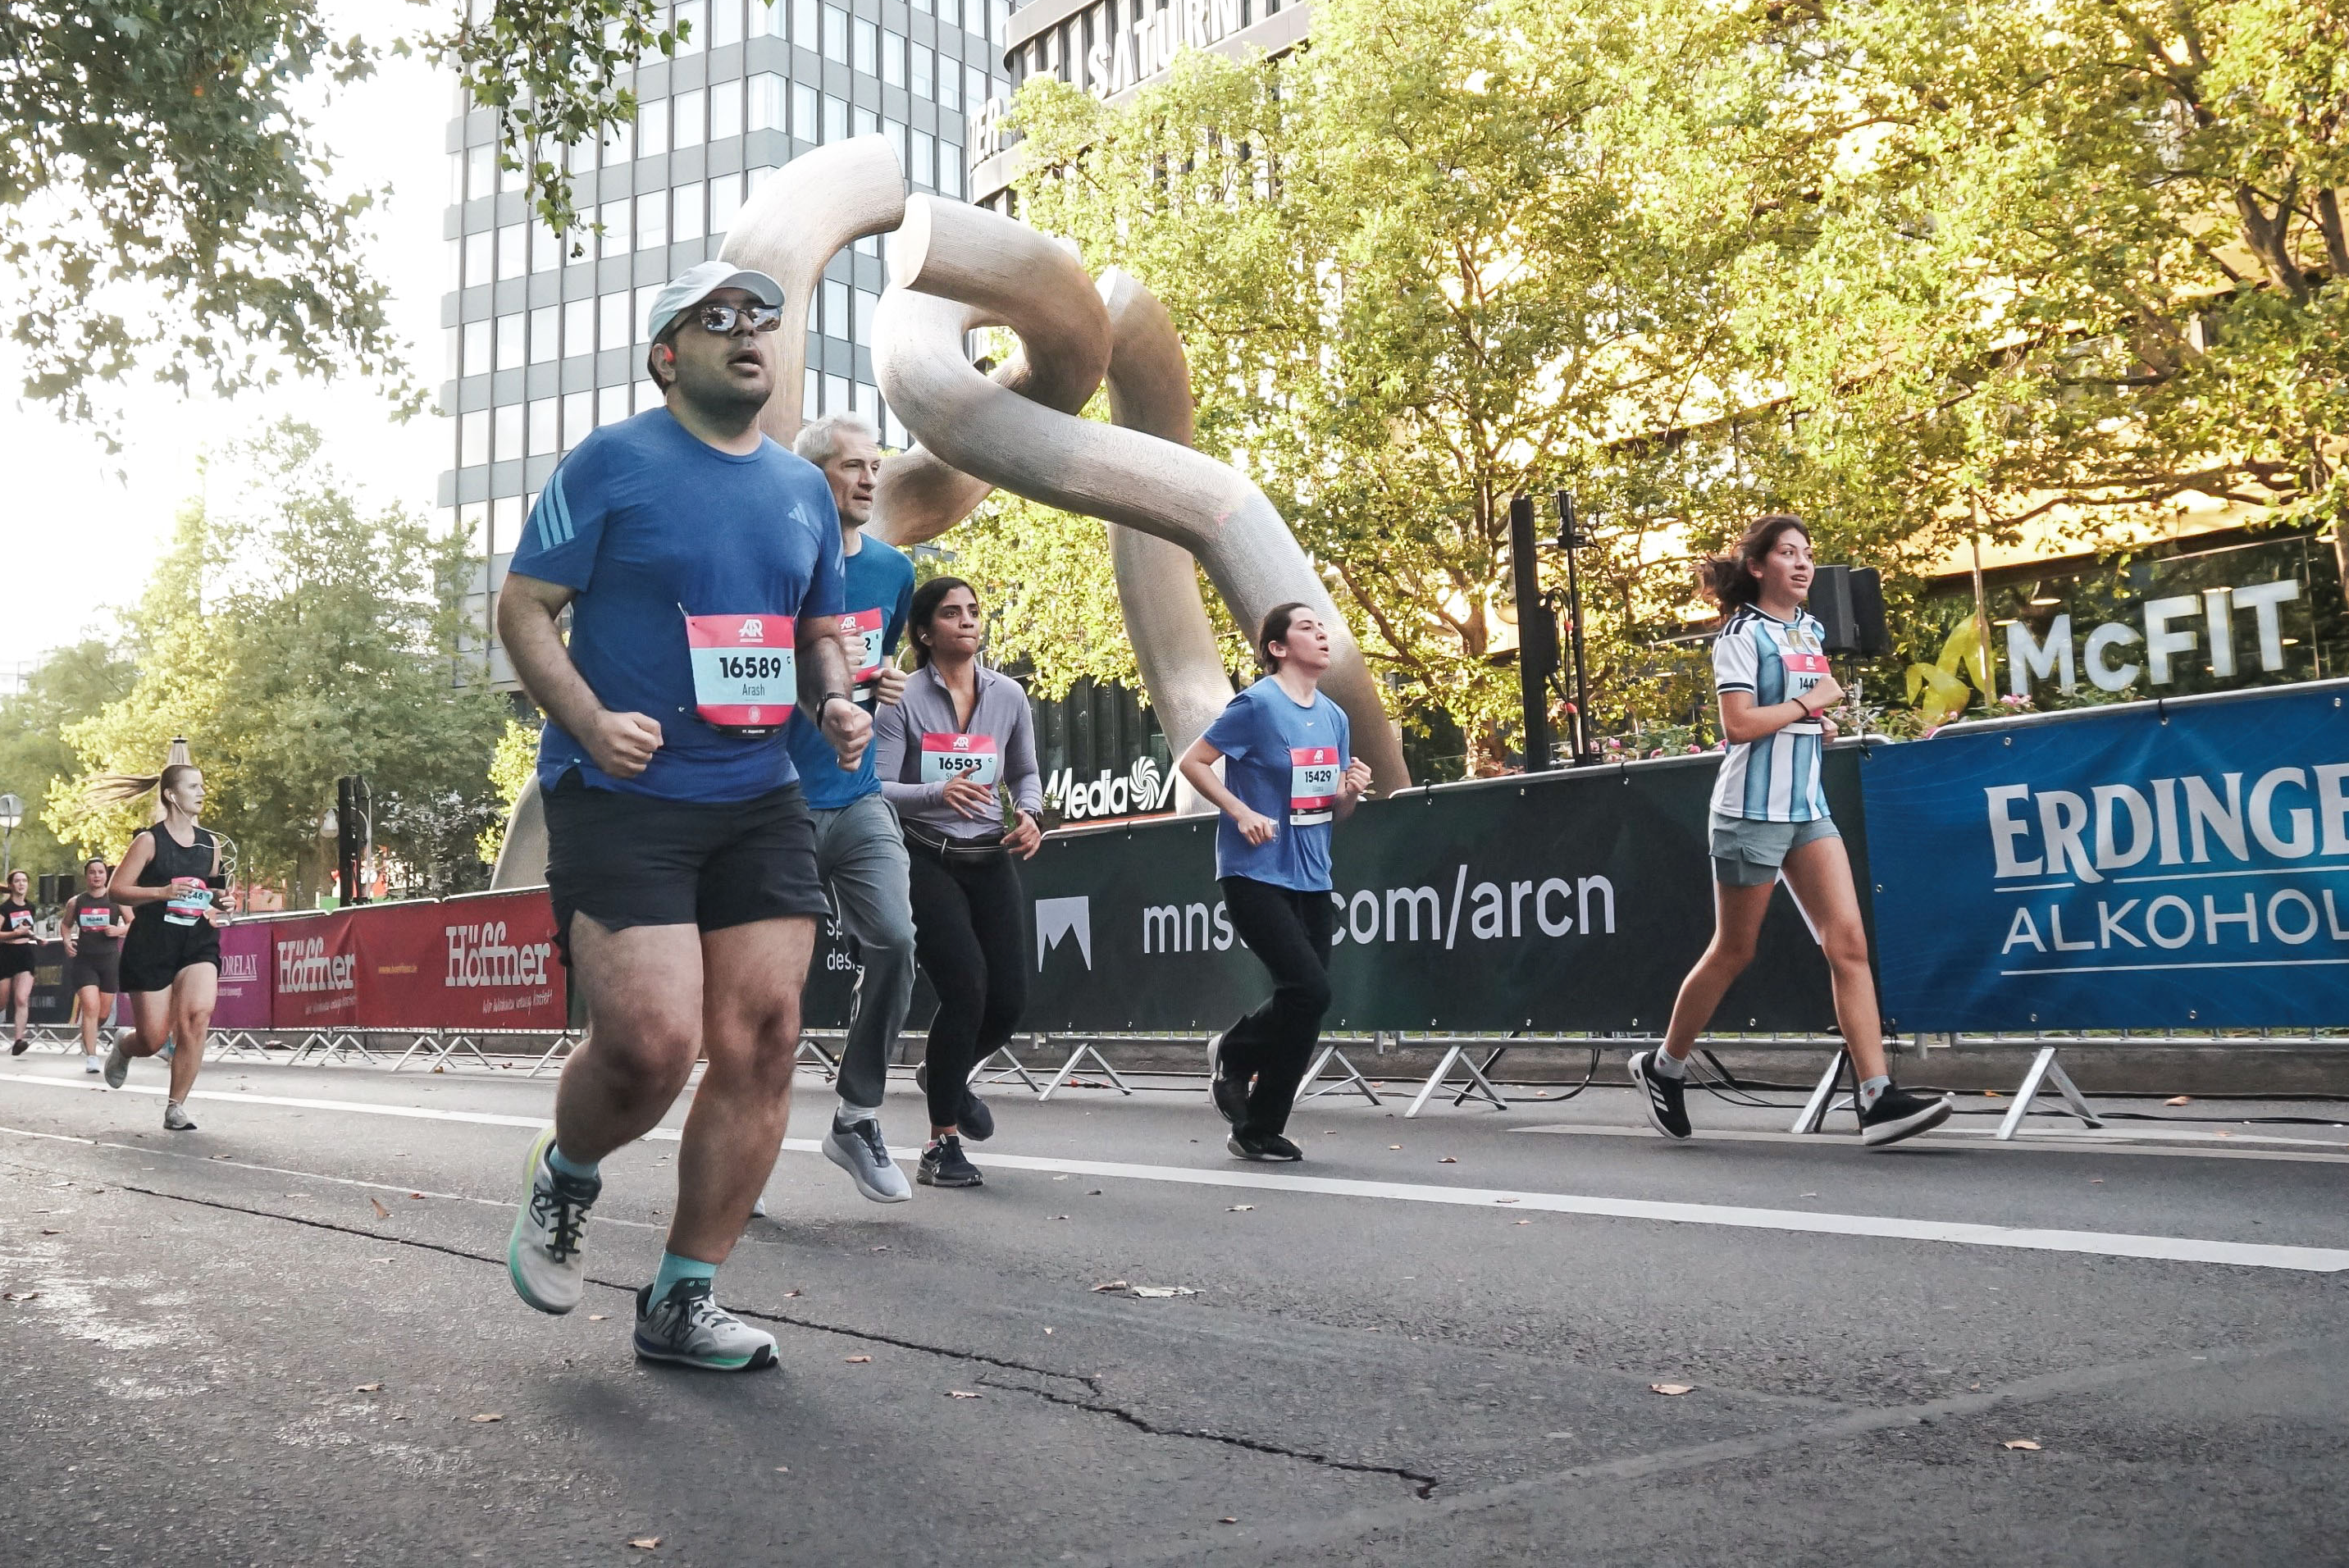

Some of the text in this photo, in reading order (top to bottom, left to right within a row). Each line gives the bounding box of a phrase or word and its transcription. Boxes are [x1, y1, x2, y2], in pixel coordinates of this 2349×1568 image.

[719, 657, 781, 678] 16589
[742, 683, 765, 696] Arash
[1042, 768, 1129, 819] Media
[1305, 770, 1331, 783] 15429
[1983, 763, 2349, 883] ERDINGE
[219, 954, 258, 976] ORELAX
[277, 936, 356, 993] Höffner
[445, 921, 551, 987] Höffner
